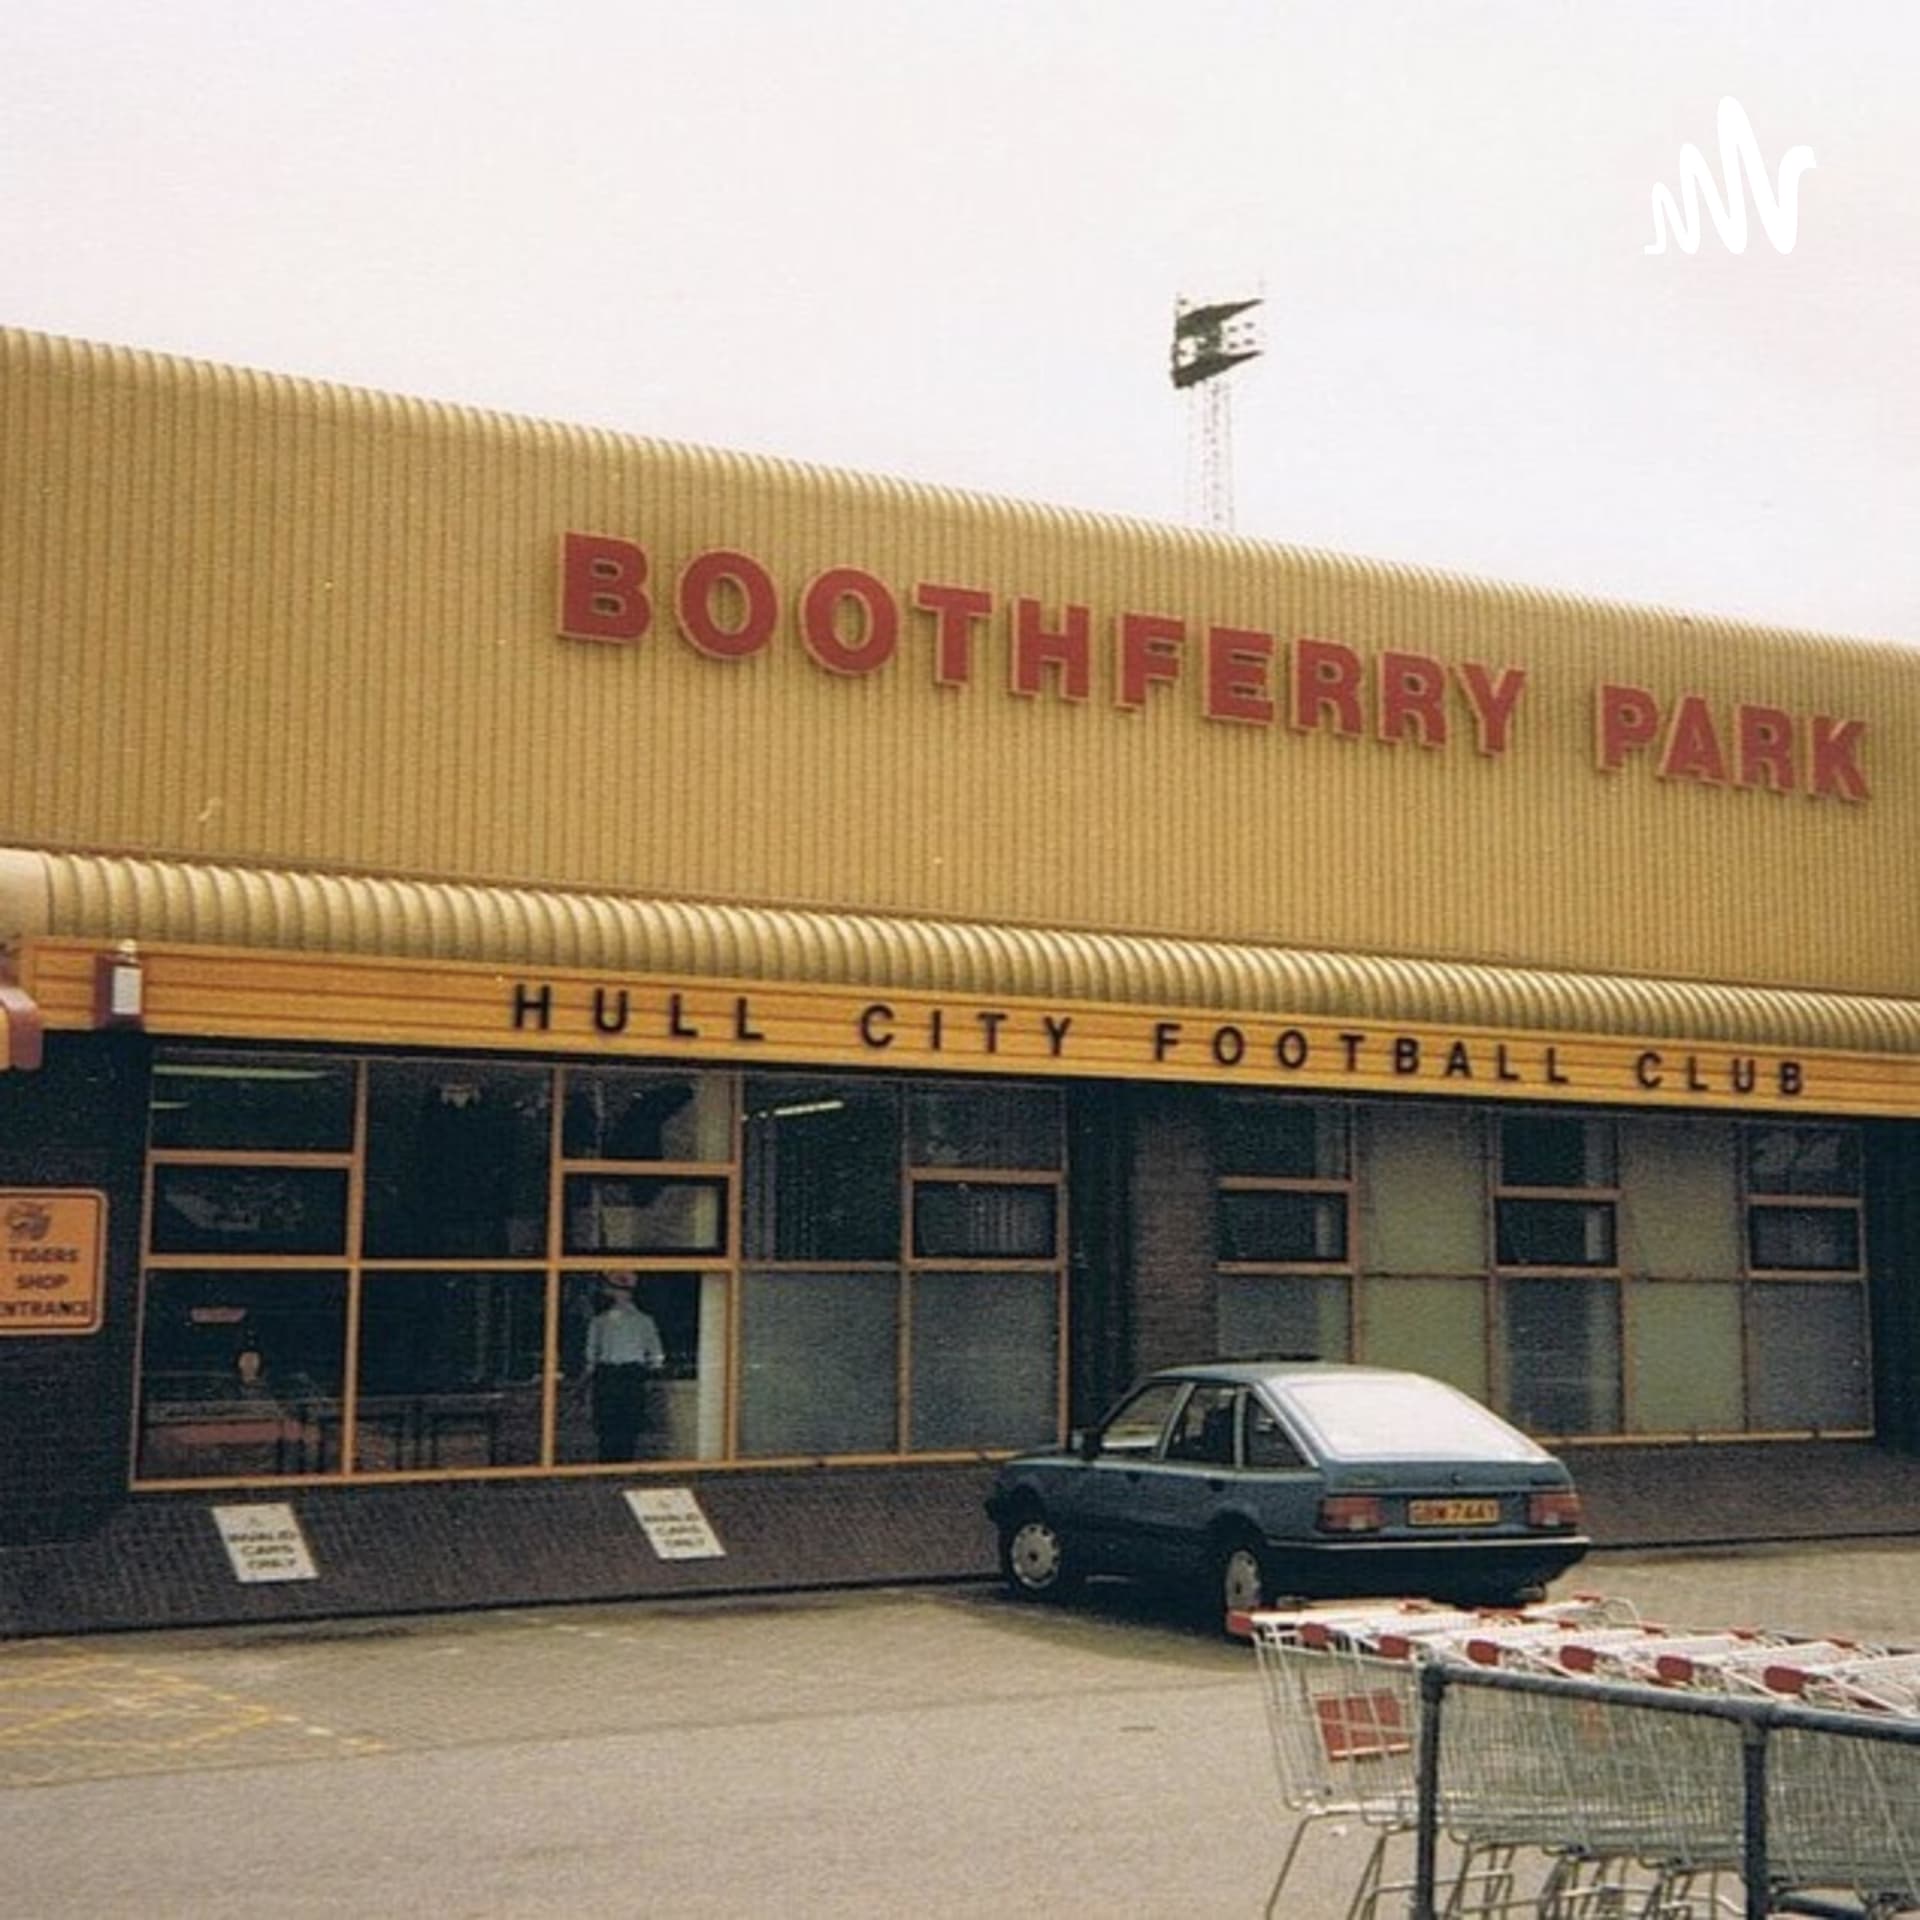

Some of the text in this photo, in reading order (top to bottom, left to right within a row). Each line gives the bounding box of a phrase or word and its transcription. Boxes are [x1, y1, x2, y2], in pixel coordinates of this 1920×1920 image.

[557, 530, 1870, 803] BOOTHFERRY PARK
[511, 983, 1805, 1096] HULL CITY FOOTBALL CLUB
[8, 1247, 80, 1263] TIGERS
[17, 1273, 70, 1290] SHOP
